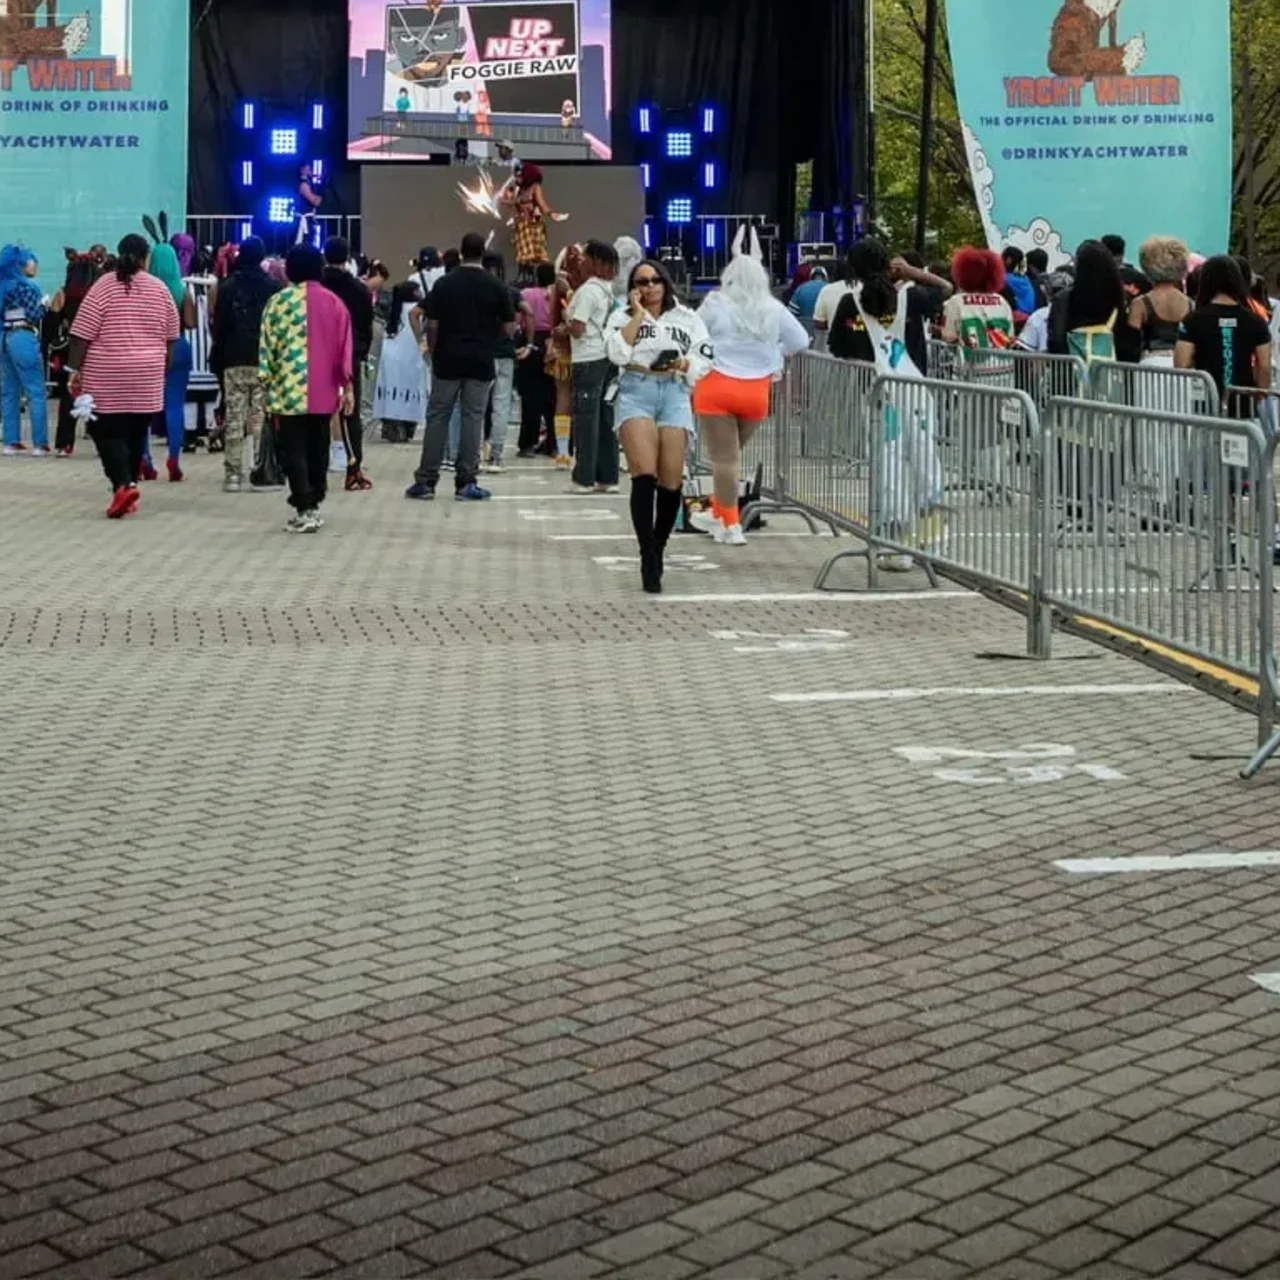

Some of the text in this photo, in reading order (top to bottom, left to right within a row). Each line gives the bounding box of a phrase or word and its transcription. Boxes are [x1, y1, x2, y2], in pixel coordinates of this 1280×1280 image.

[509, 18, 552, 39] UP
[484, 37, 566, 58] NEXT
[450, 58, 577, 80] FOGGIE RAW
[1003, 74, 1181, 108] YACHT WATER
[1, 99, 54, 112] DRINK
[60, 99, 82, 112] OF
[86, 99, 169, 112] DRINKING
[980, 113, 1214, 127] THE OFFICIAL DRINK OF DRINKING
[1001, 144, 1189, 160] @DRINKYACHTWATER
